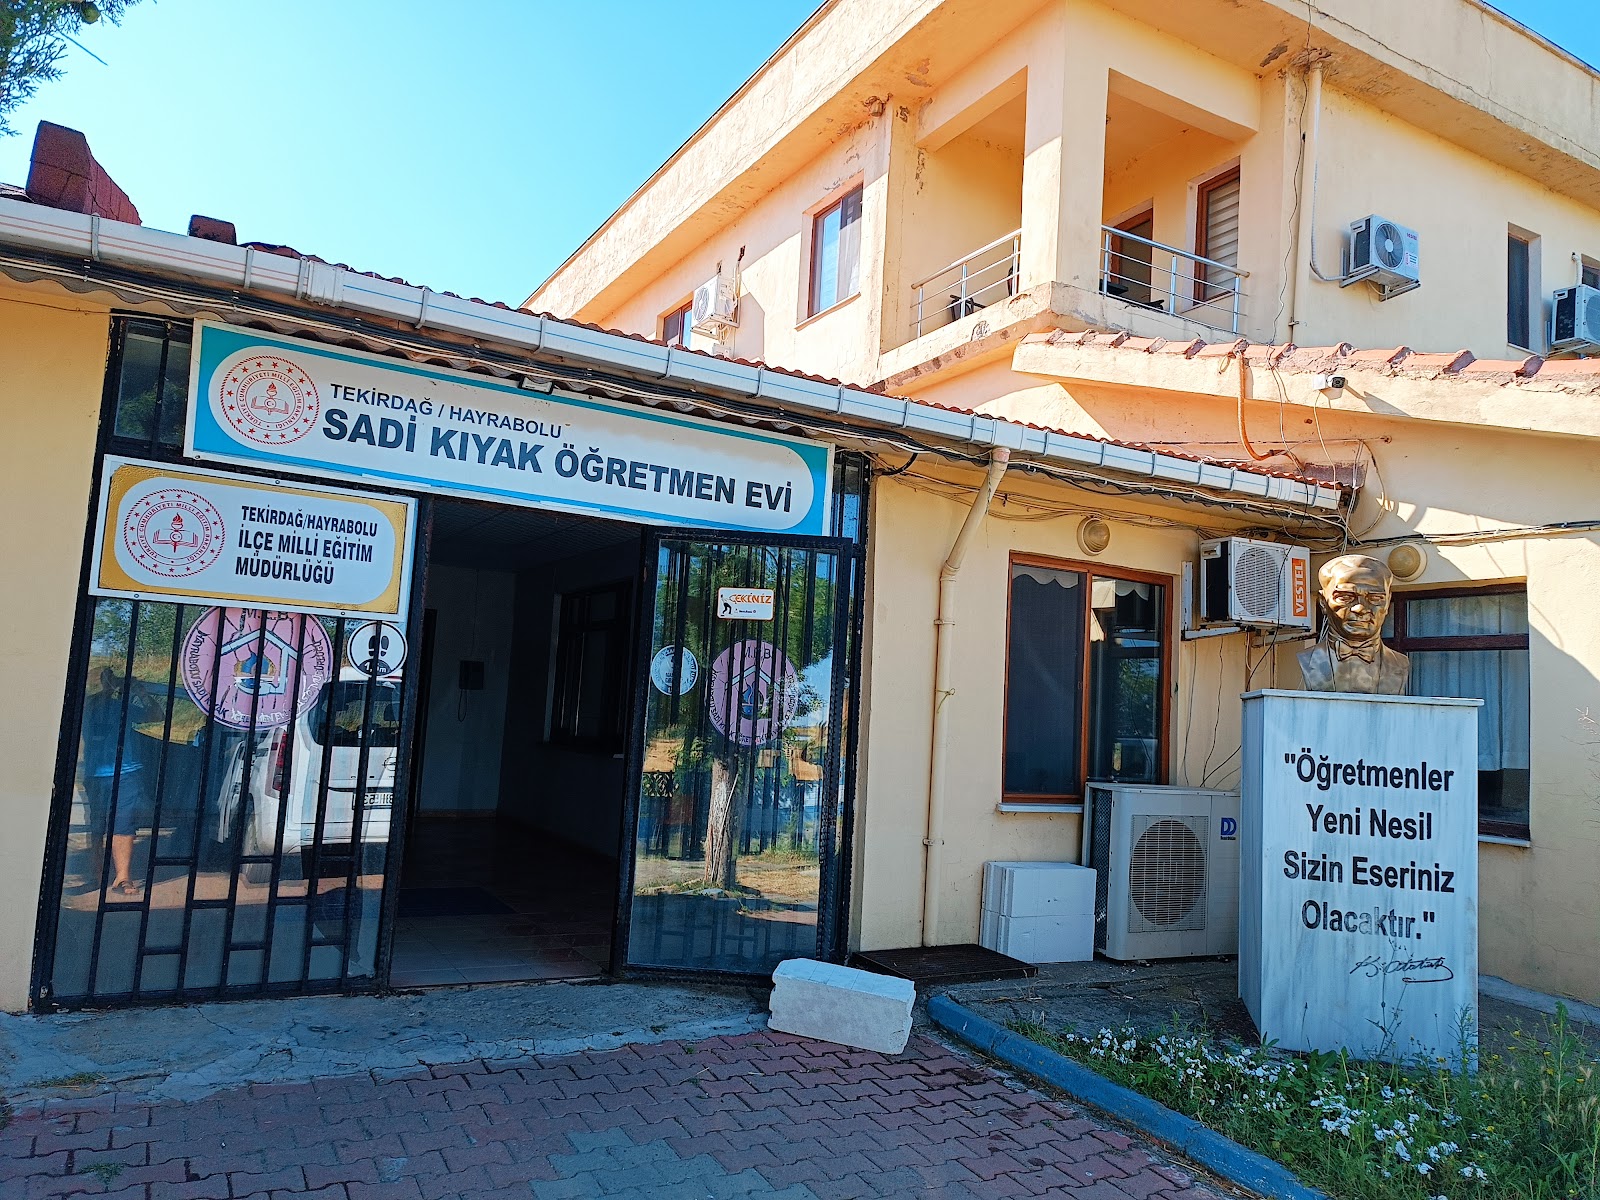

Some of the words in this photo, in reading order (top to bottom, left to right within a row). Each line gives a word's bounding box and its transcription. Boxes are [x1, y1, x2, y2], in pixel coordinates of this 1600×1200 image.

[330, 383, 433, 416] TEKİRDAĞ
[450, 406, 562, 439] HAYRABOLU
[322, 408, 417, 453] SADİ
[430, 426, 545, 474] KIYAK
[554, 443, 736, 504] ÖĞRETMEN
[745, 481, 793, 513] EVİ
[241, 504, 378, 537] TEKİRDAĞ/HAYRABOLU
[238, 523, 274, 552] İLÇE
[278, 530, 319, 556] MİLLİ
[323, 535, 373, 563] EĞİTİM
[235, 552, 334, 584] MÜDÜRLÜĞÜ
[1295, 561, 1305, 614] VESTEL
[729, 592, 772, 604] ÇEKİNİZ
[1284, 747, 1455, 792] "Öğretmenler
[1306, 803, 1361, 835] Yeni
[1370, 808, 1432, 841] Nesil
[1283, 850, 1343, 883] Sizin
[1352, 856, 1455, 893] Eseriniz
[1302, 900, 1435, 940] Olacaktır."
